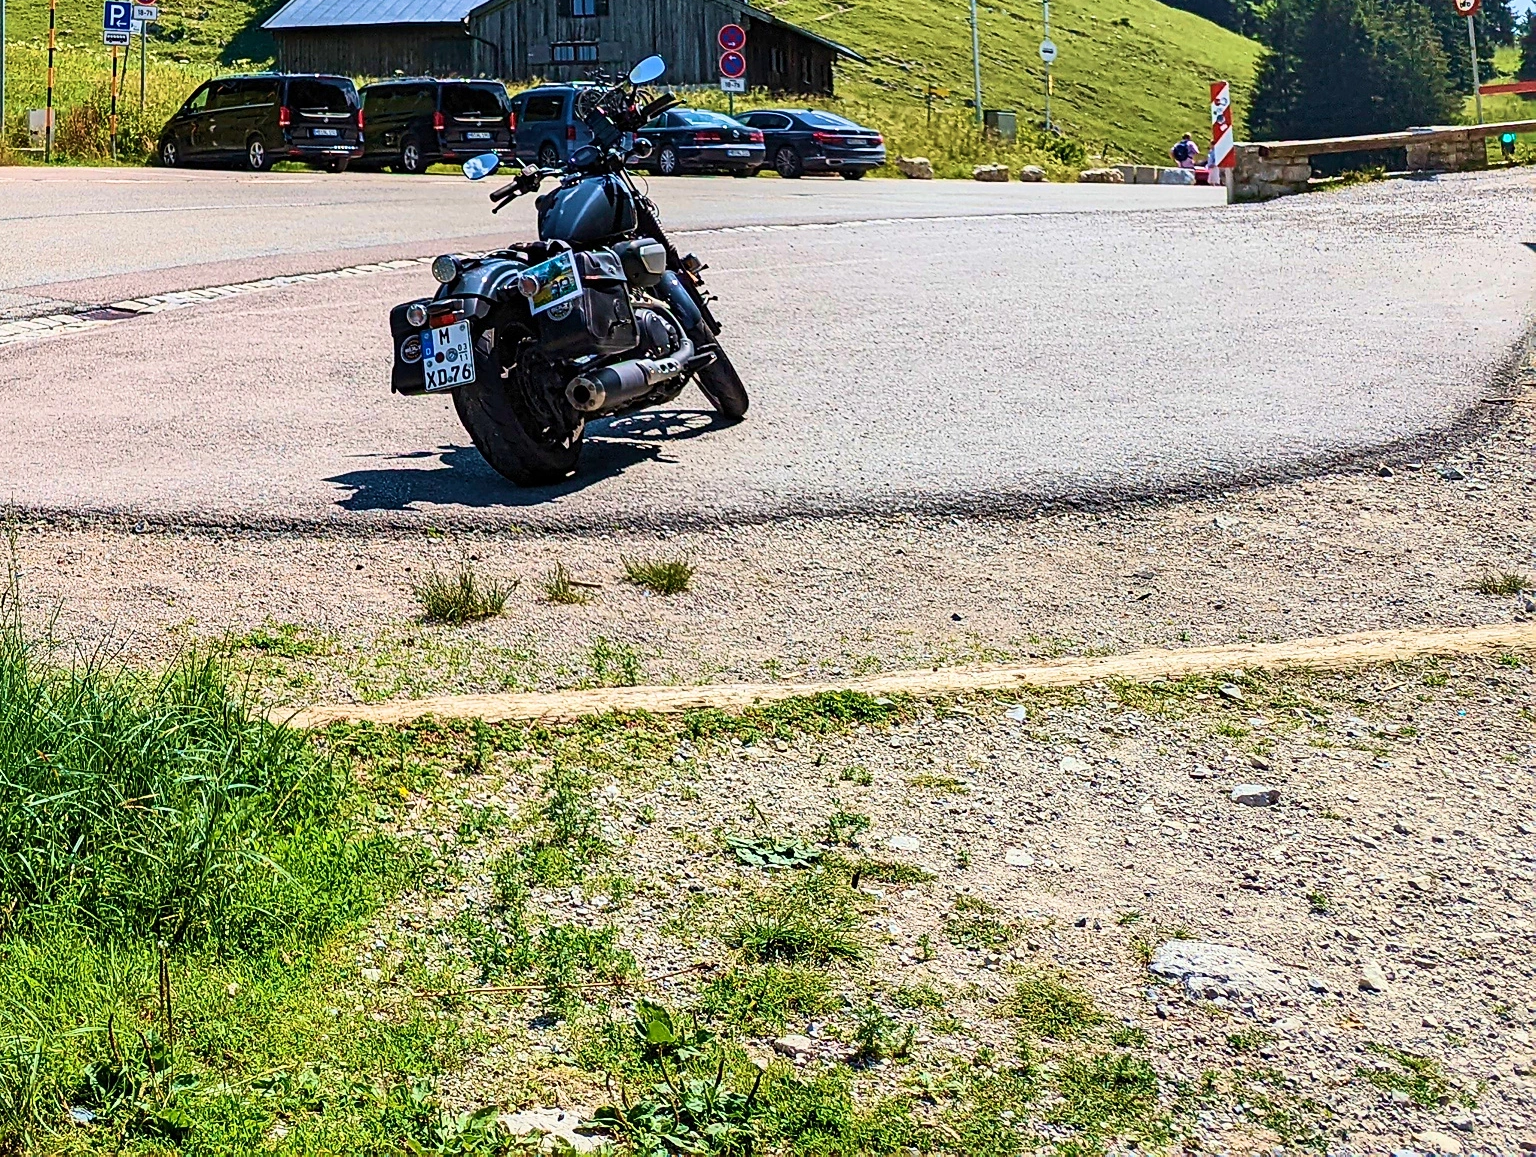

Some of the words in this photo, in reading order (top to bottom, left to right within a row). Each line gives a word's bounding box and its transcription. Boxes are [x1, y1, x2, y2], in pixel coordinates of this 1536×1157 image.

[109, 4, 125, 26] P
[438, 327, 450, 345] M
[425, 347, 432, 355] D
